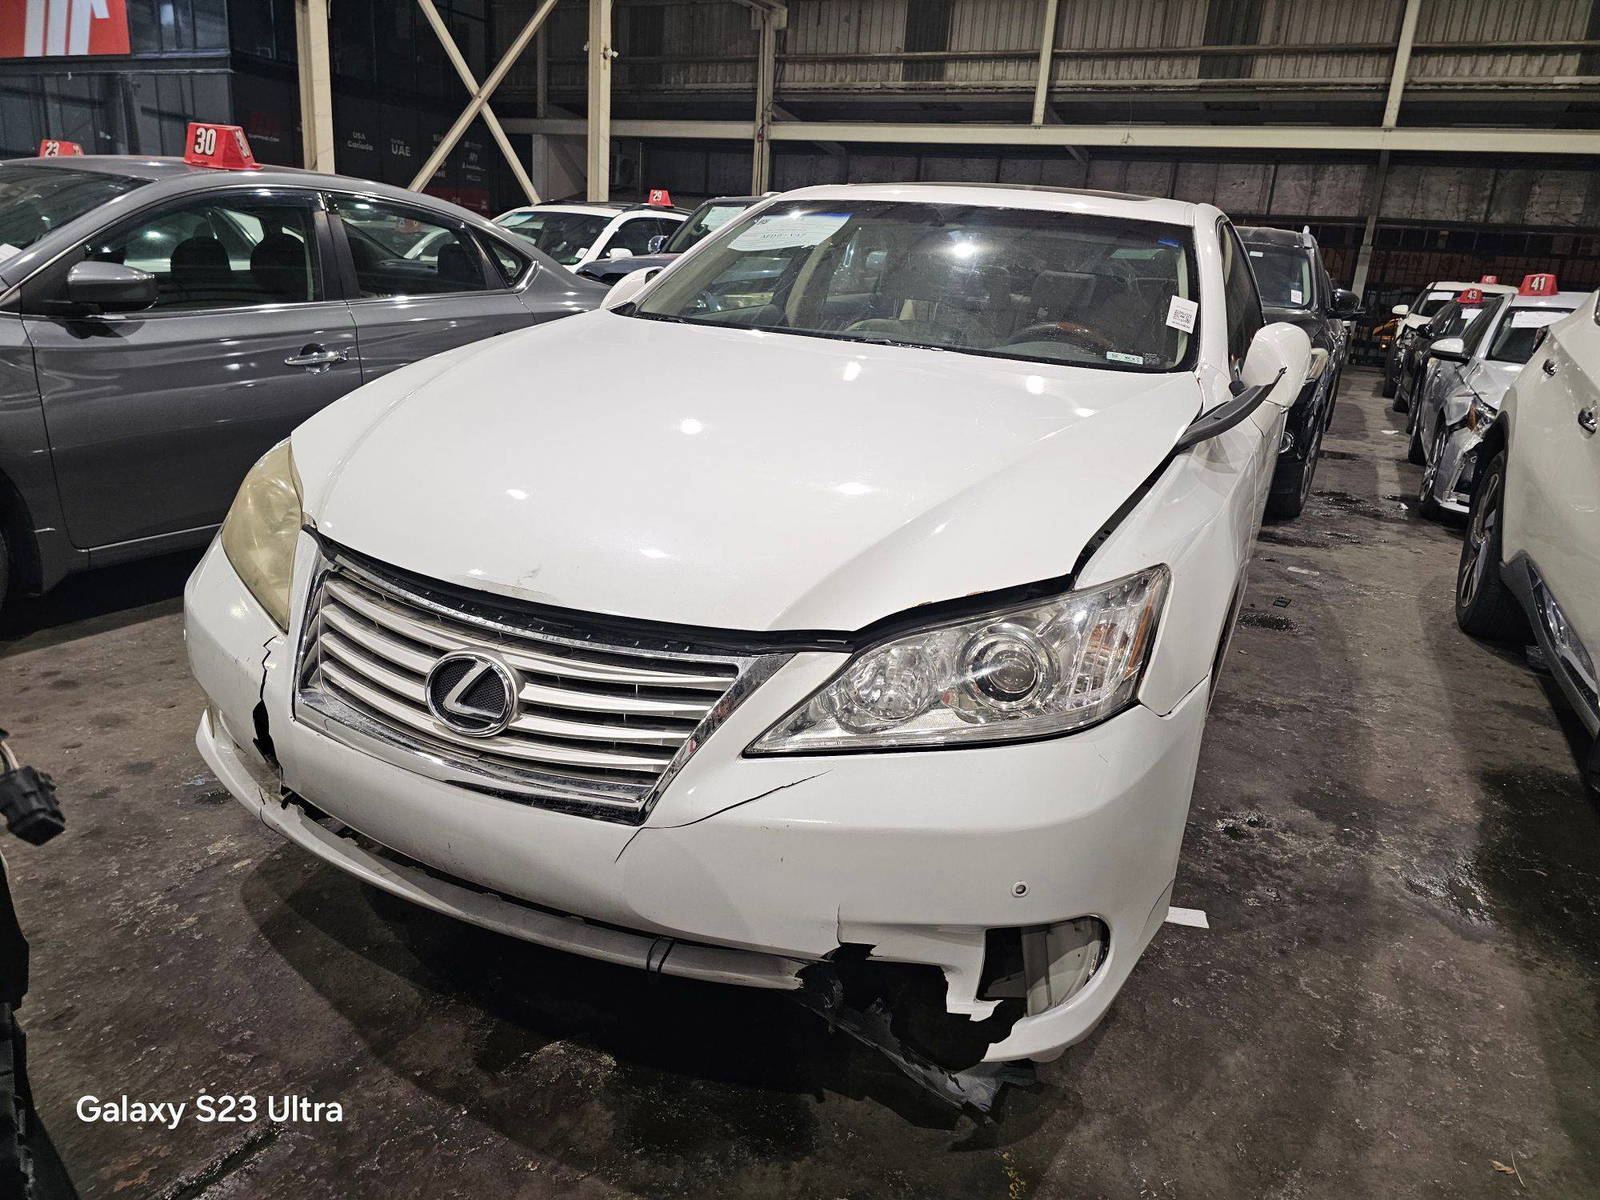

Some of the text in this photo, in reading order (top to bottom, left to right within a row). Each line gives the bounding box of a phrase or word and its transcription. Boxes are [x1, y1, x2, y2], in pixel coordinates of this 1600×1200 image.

[194, 127, 215, 155] 30
[391, 143, 411, 157] UAE
[1530, 276, 1546, 291] 41
[1467, 290, 1477, 300] 43
